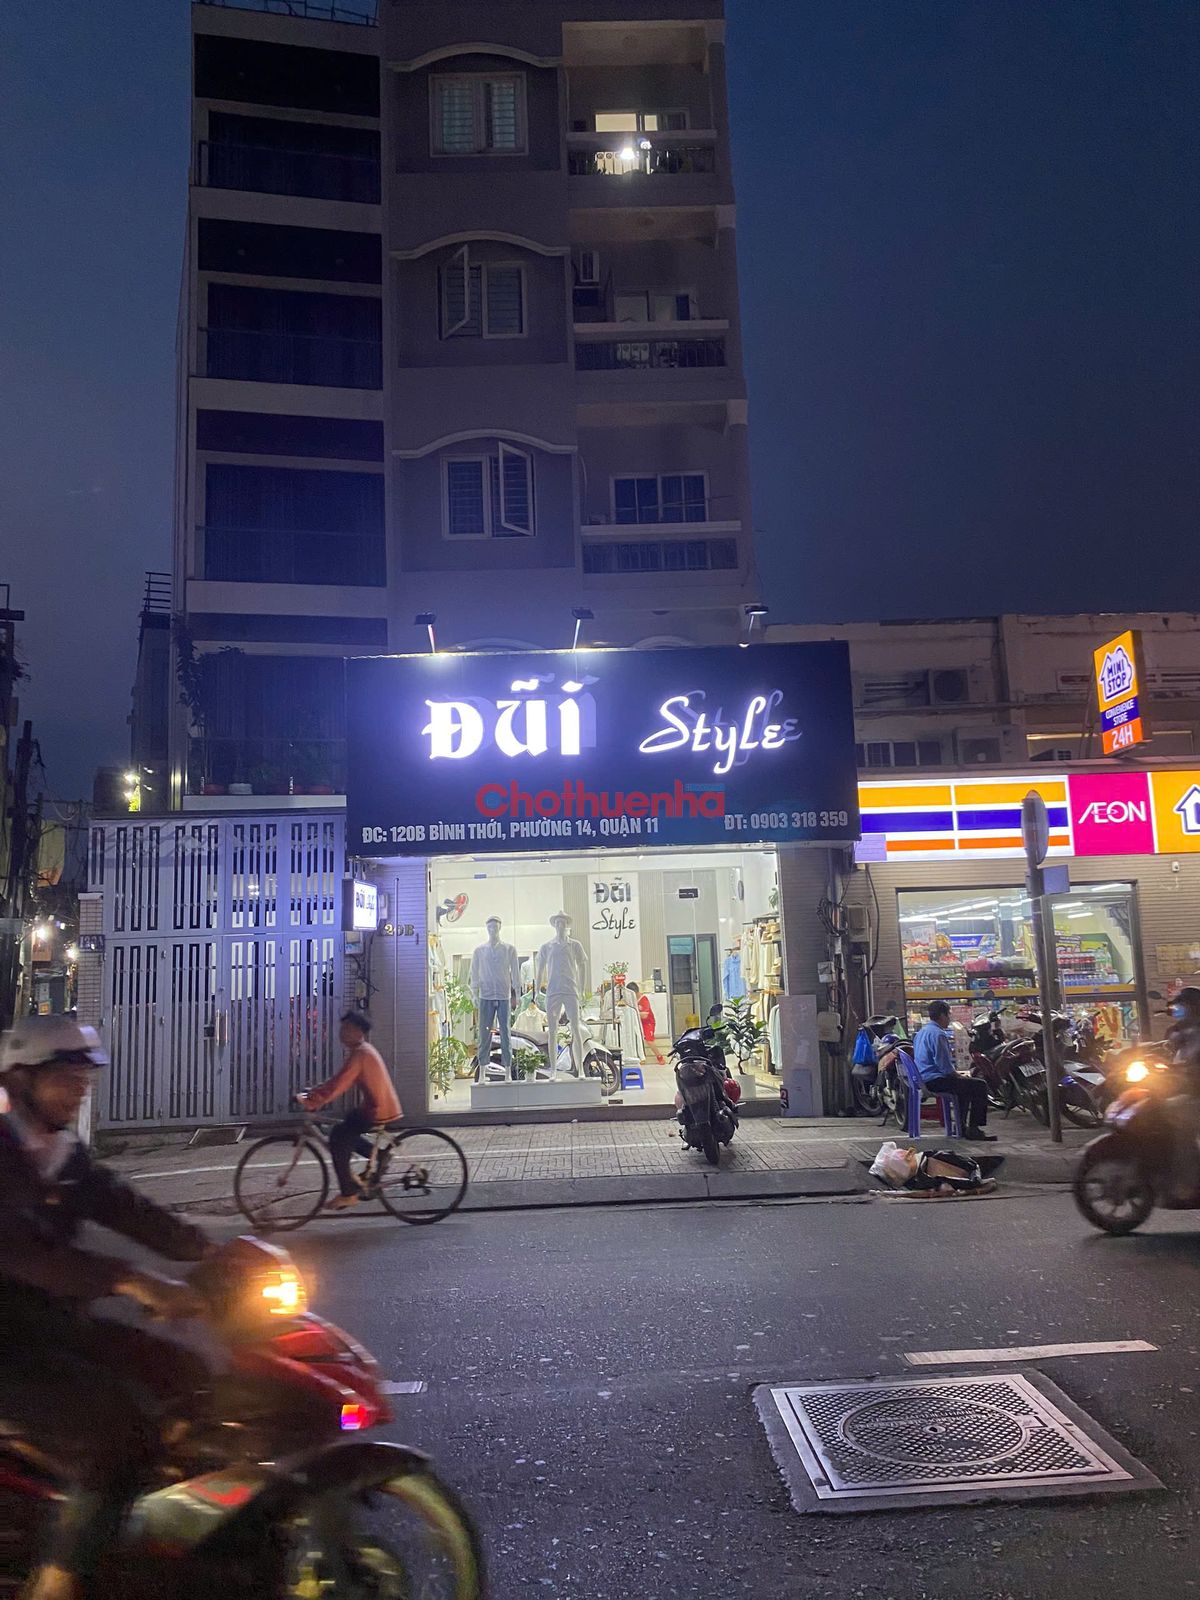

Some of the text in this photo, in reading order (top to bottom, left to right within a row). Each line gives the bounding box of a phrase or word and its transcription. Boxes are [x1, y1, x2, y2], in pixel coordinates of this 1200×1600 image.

[1106, 658, 1125, 678] MINI
[1107, 672, 1127, 693] STOP
[1112, 712, 1129, 726] STORE
[1111, 724, 1133, 750] 24H
[362, 815, 659, 844] ĐC: 120B BÌNH THỚI, PHƯỜNG 14, QUẬN 11
[724, 811, 849, 831] ĐT: 0903 318 359
[592, 906, 636, 940] Style
